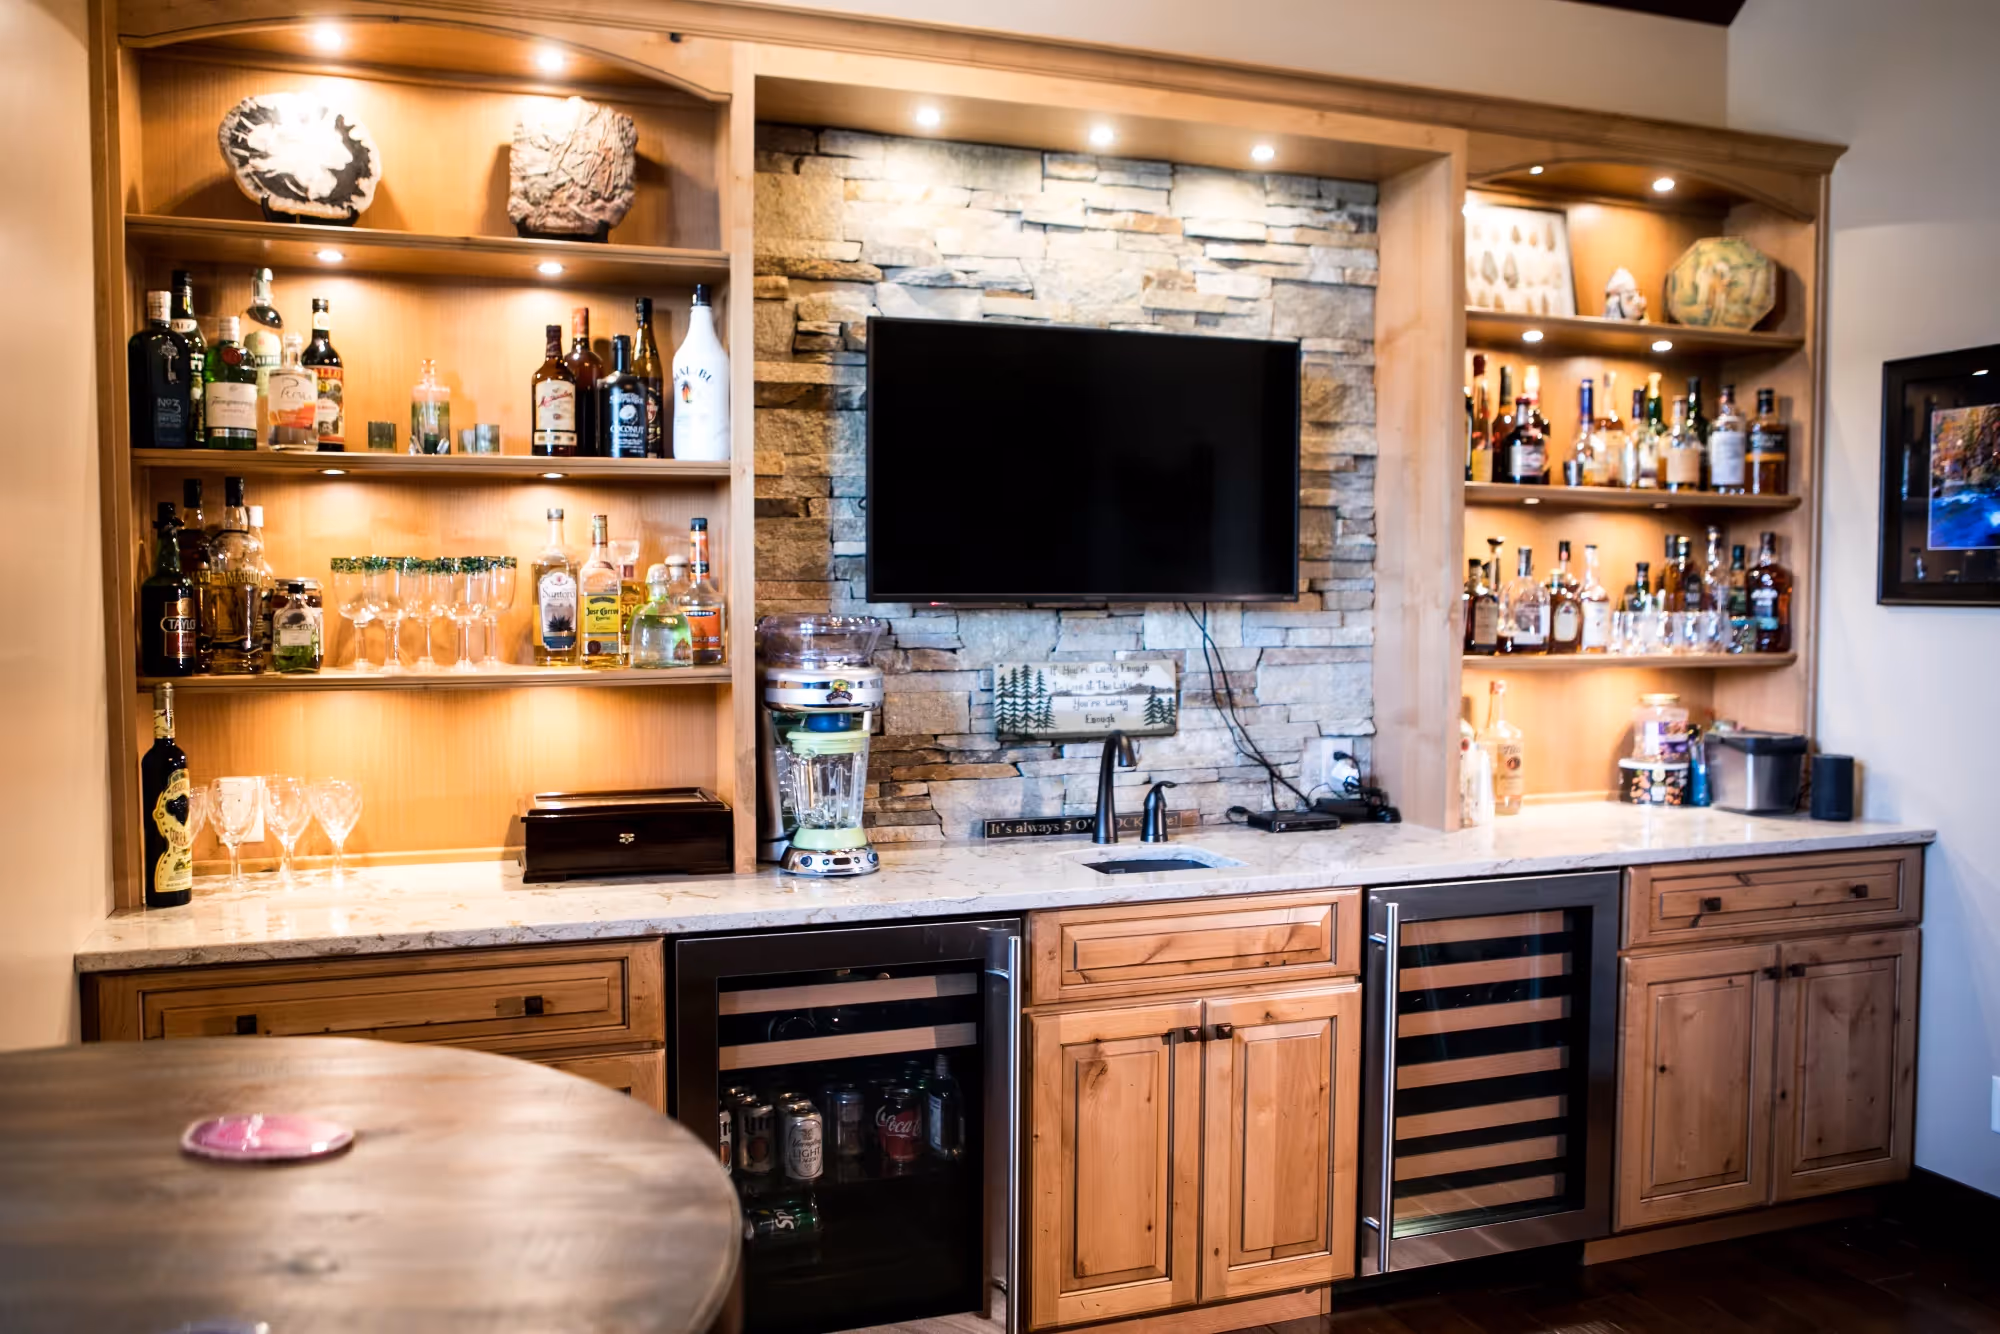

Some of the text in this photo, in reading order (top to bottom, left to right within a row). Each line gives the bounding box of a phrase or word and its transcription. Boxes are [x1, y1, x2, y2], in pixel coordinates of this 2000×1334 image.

[168, 618, 196, 630] TAYLO
[1085, 713, 1115, 728] Enough
[991, 823, 1012, 834] It's
[1015, 821, 1060, 835] always
[1064, 819, 1072, 831] 5
[794, 1146, 820, 1158] LIGHT
